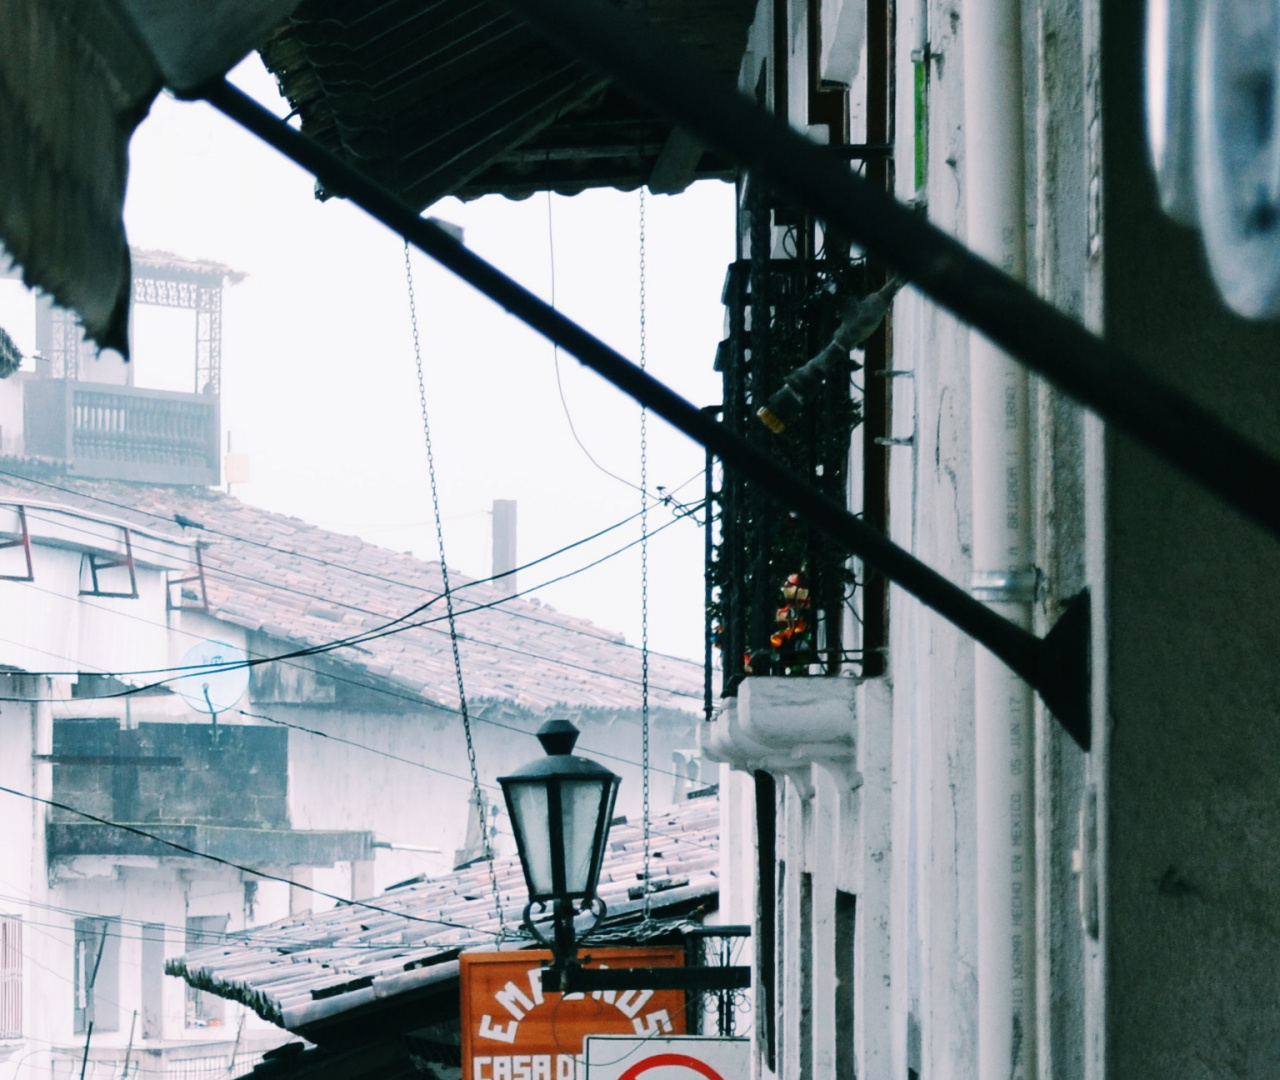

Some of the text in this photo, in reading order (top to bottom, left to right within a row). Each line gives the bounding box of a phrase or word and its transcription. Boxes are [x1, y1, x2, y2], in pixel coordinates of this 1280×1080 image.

[1006, 466, 1019, 530] BRIGADA
[1009, 793, 1022, 847] MEXICO
[1010, 854, 1023, 874] EN
[1010, 881, 1023, 927] HECHO
[1011, 934, 1024, 980] NORMA
